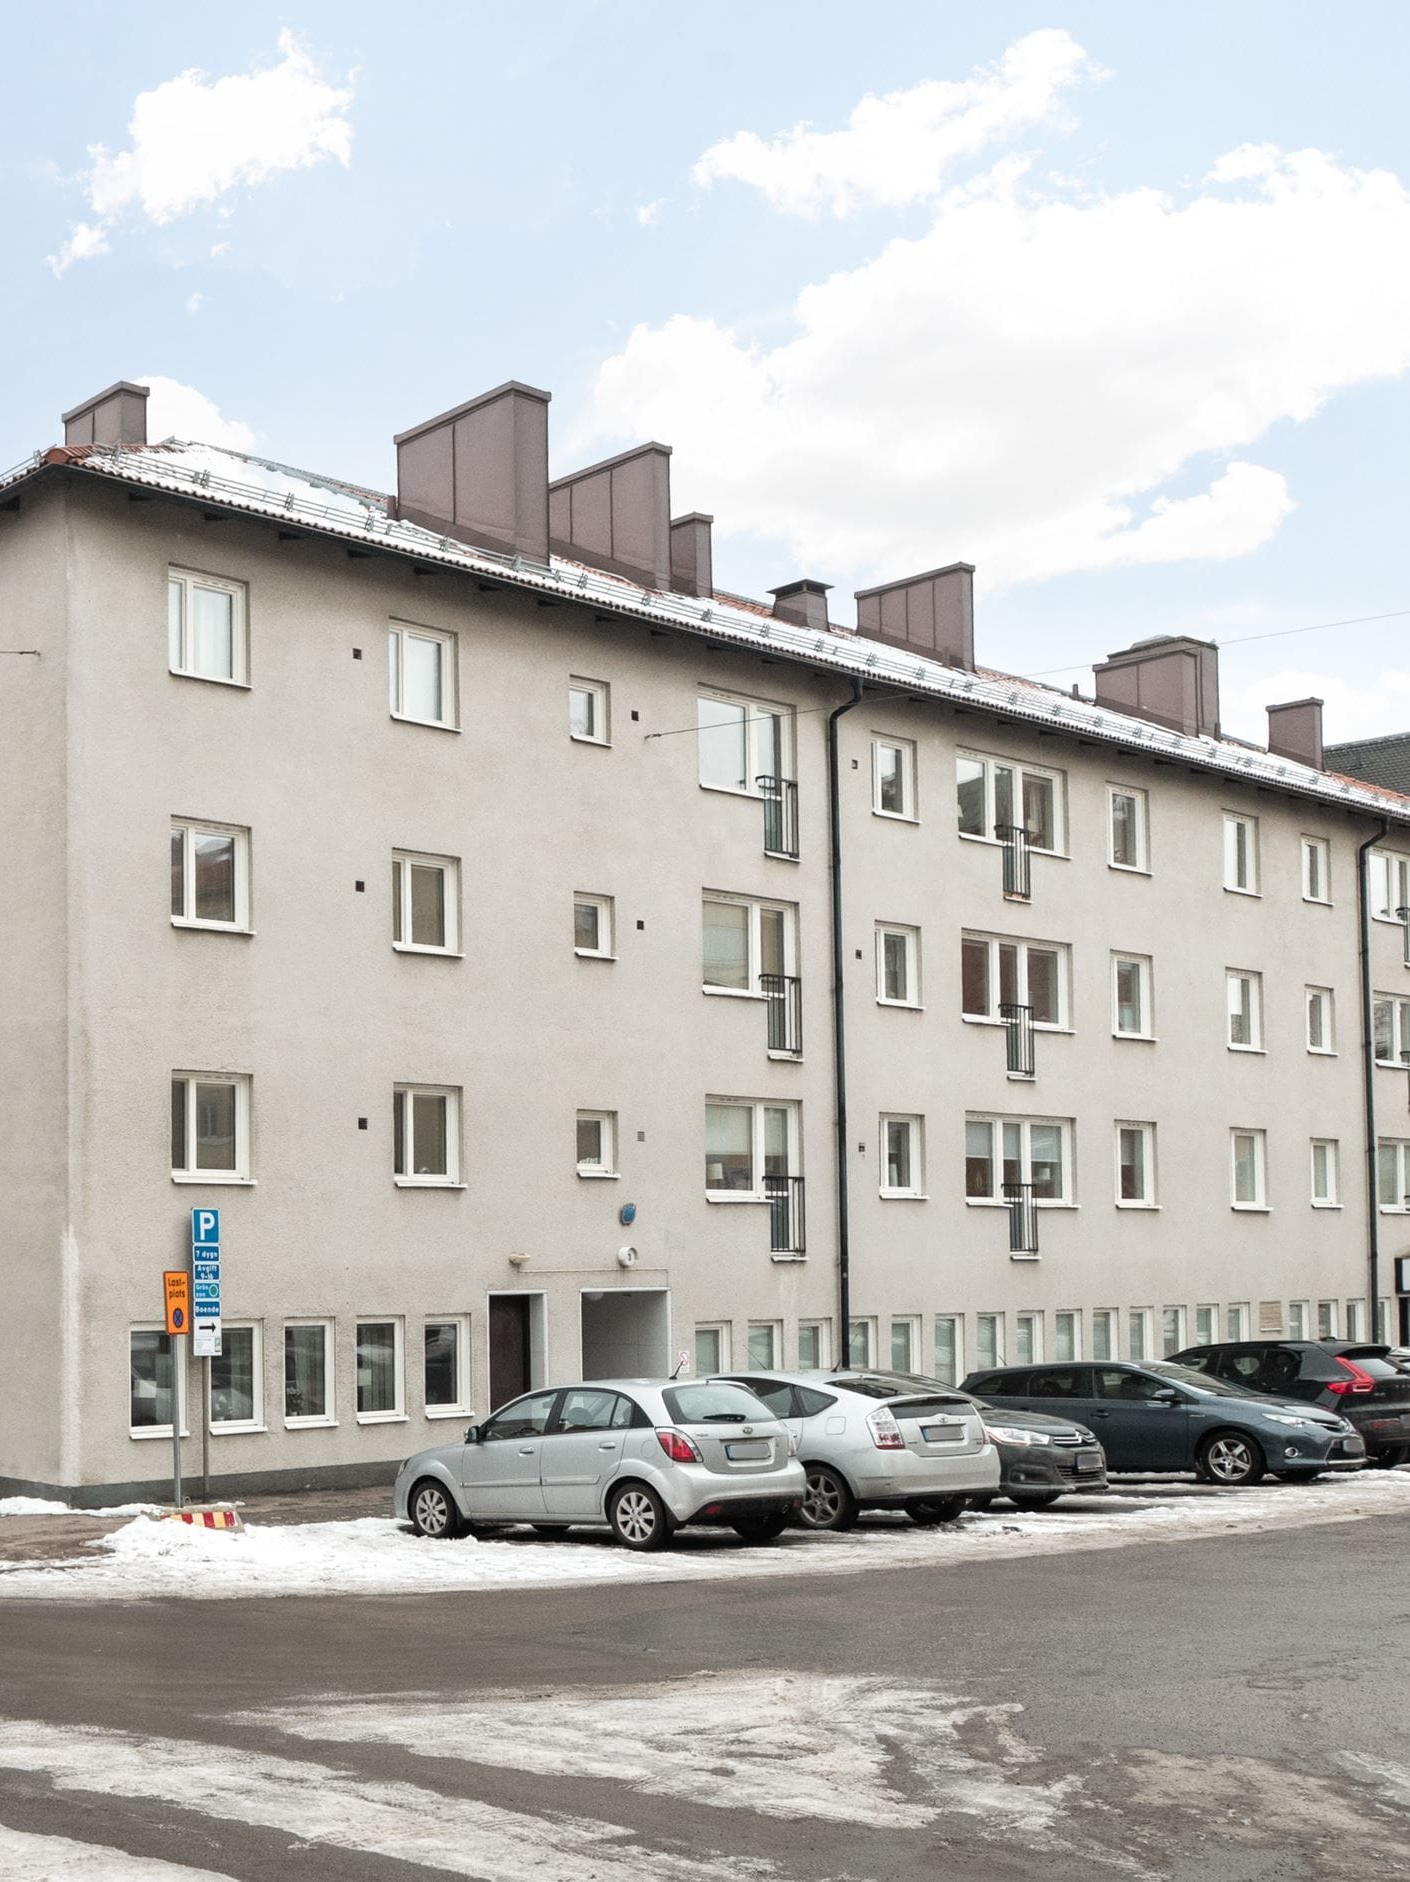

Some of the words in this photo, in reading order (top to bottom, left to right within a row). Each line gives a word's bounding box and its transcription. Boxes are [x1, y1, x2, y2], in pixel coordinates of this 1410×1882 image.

[199, 1211, 215, 1241] P
[168, 1278, 185, 1286] Last-
[169, 1288, 185, 1299] plats
[195, 1305, 219, 1313] Boende
